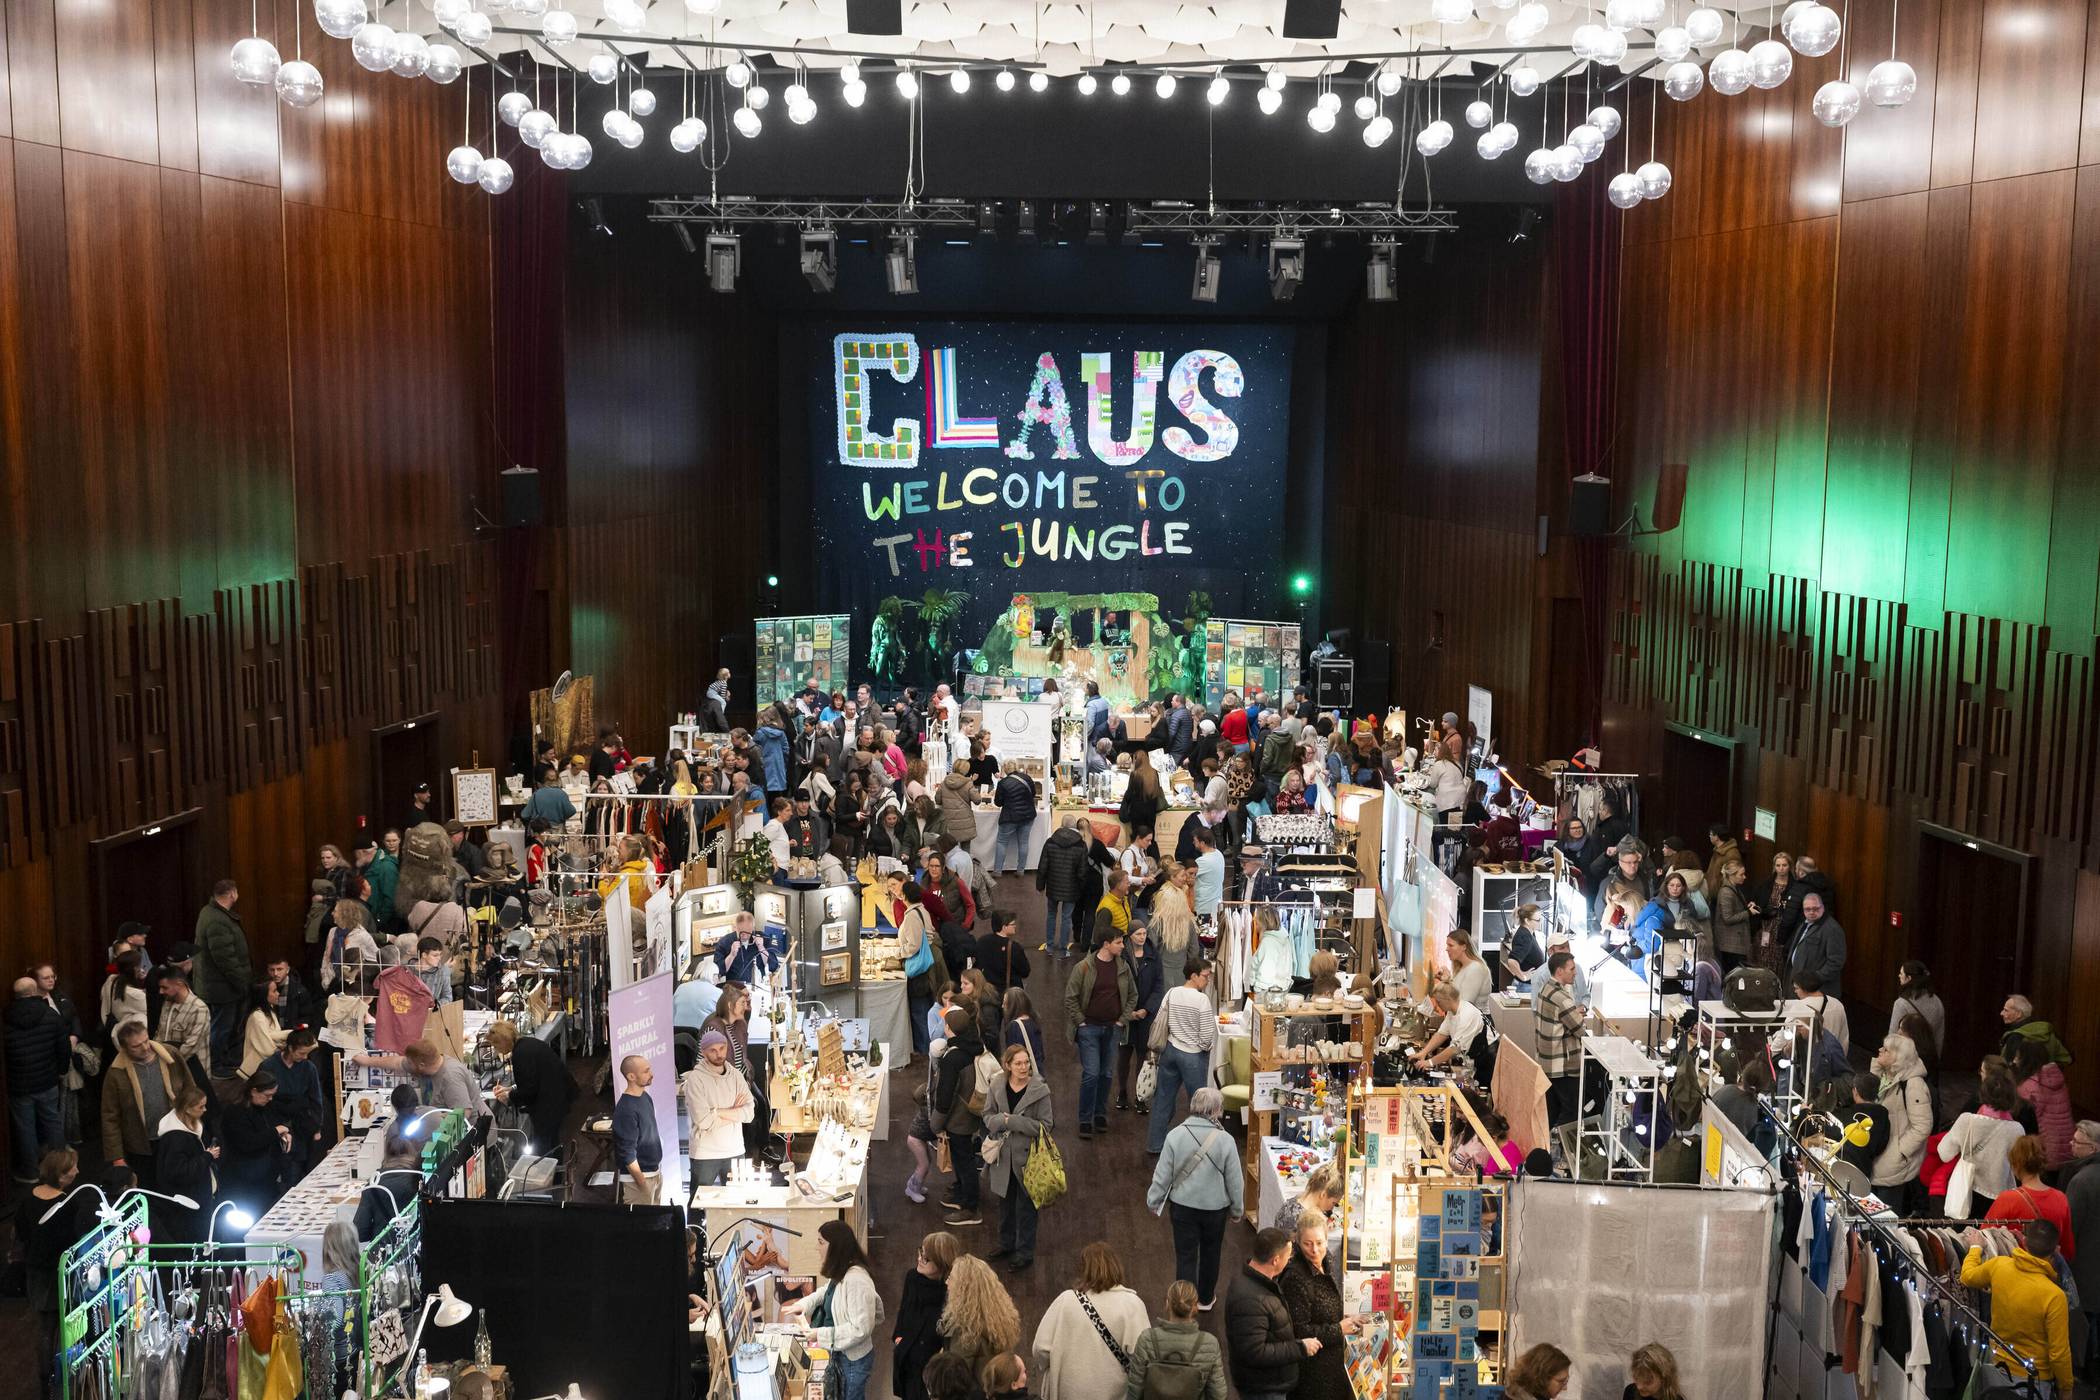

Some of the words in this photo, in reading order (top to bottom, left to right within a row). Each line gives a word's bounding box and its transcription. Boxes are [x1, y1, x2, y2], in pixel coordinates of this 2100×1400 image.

[834, 332, 1244, 468] CLAUS
[863, 467, 1099, 521] WELCOME
[1125, 470, 1186, 512] TO
[873, 527, 973, 577] THE
[1000, 518, 1193, 568] JUNGLE
[616, 1014, 656, 1040] SPARKLY
[618, 1031, 659, 1057] NATURAL
